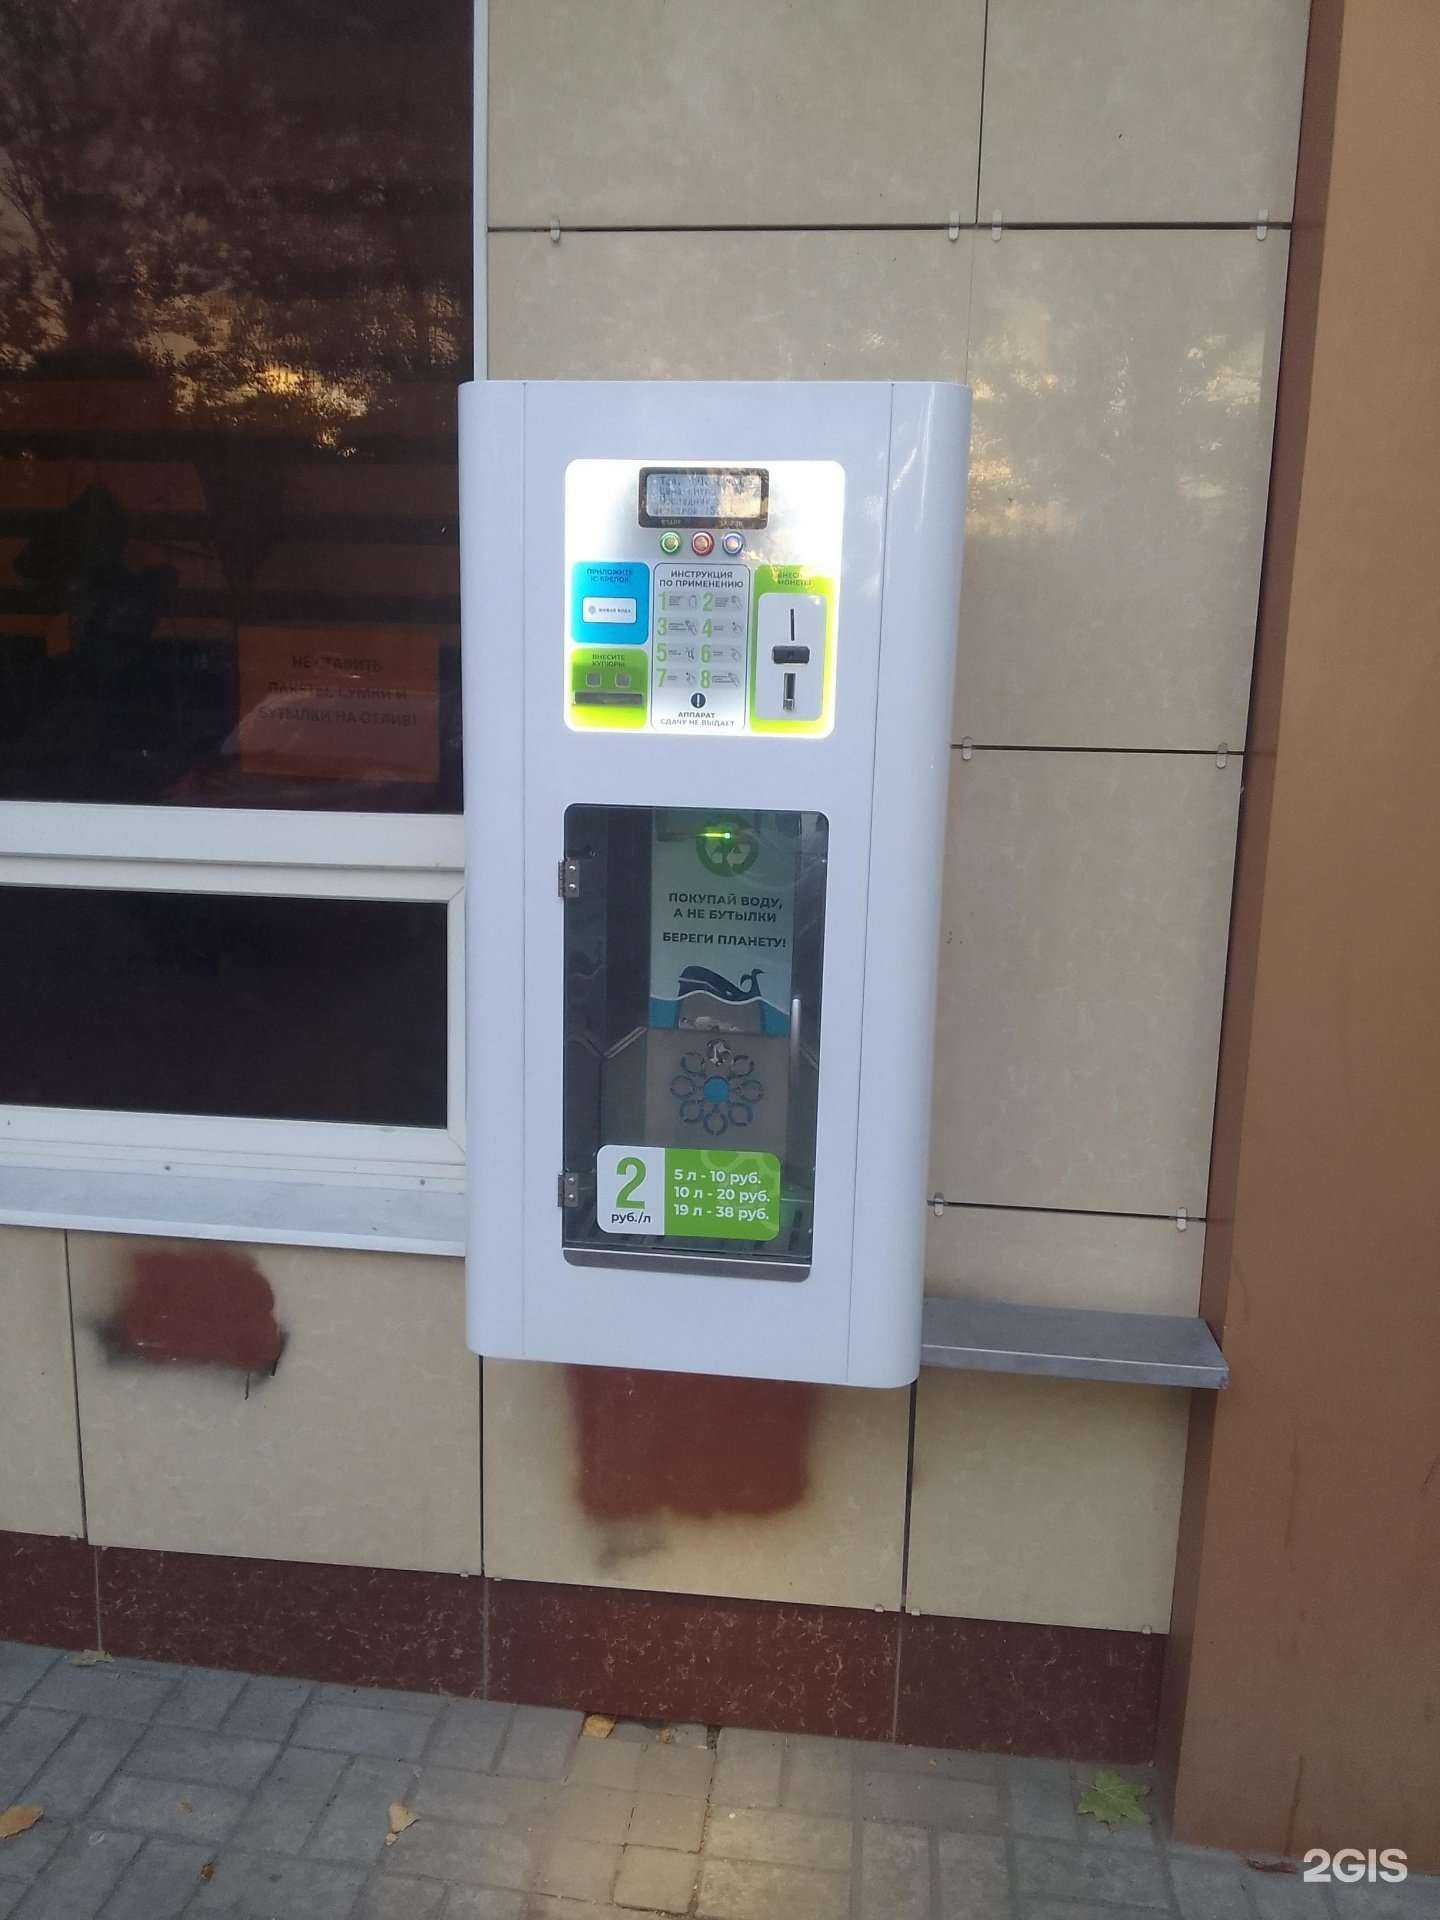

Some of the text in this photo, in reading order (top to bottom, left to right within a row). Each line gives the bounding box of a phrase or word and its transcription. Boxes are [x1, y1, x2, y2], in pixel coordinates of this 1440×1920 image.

[671, 570, 733, 578] ИНСТРУКЦИЯ
[660, 579, 744, 588] ПО ПРИМЕНЕНИЮ
[658, 592, 666, 610] 1
[703, 592, 713, 611] 2
[657, 617, 667, 635] 3
[702, 619, 712, 638] 4
[656, 643, 667, 661] 5
[701, 644, 711, 663] 6
[656, 669, 667, 687] 7
[701, 670, 710, 688] 8
[678, 711, 715, 719] АППАРАТ
[669, 892, 783, 910] ПОКУПАЙ ВОДУ,
[674, 908, 776, 923] А НЕ БУТЫЛКИ
[663, 932, 786, 948] БЕРЕГИ ПЛАНЕТУ!
[616, 1156, 647, 1209] 2
[674, 1169, 683, 1181] 5
[686, 1171, 697, 1181] л
[710, 1170, 726, 1183] 10
[729, 1172, 762, 1186] руб.
[673, 1186, 690, 1198] 10
[692, 1188, 703, 1199] л
[716, 1188, 735, 1201] 20
[739, 1189, 770, 1203] руб.
[611, 1211, 651, 1224] руб./л
[673, 1204, 689, 1216] 19
[692, 1206, 703, 1217] л
[716, 1206, 734, 1218] 38
[738, 1207, 769, 1221] руб.
